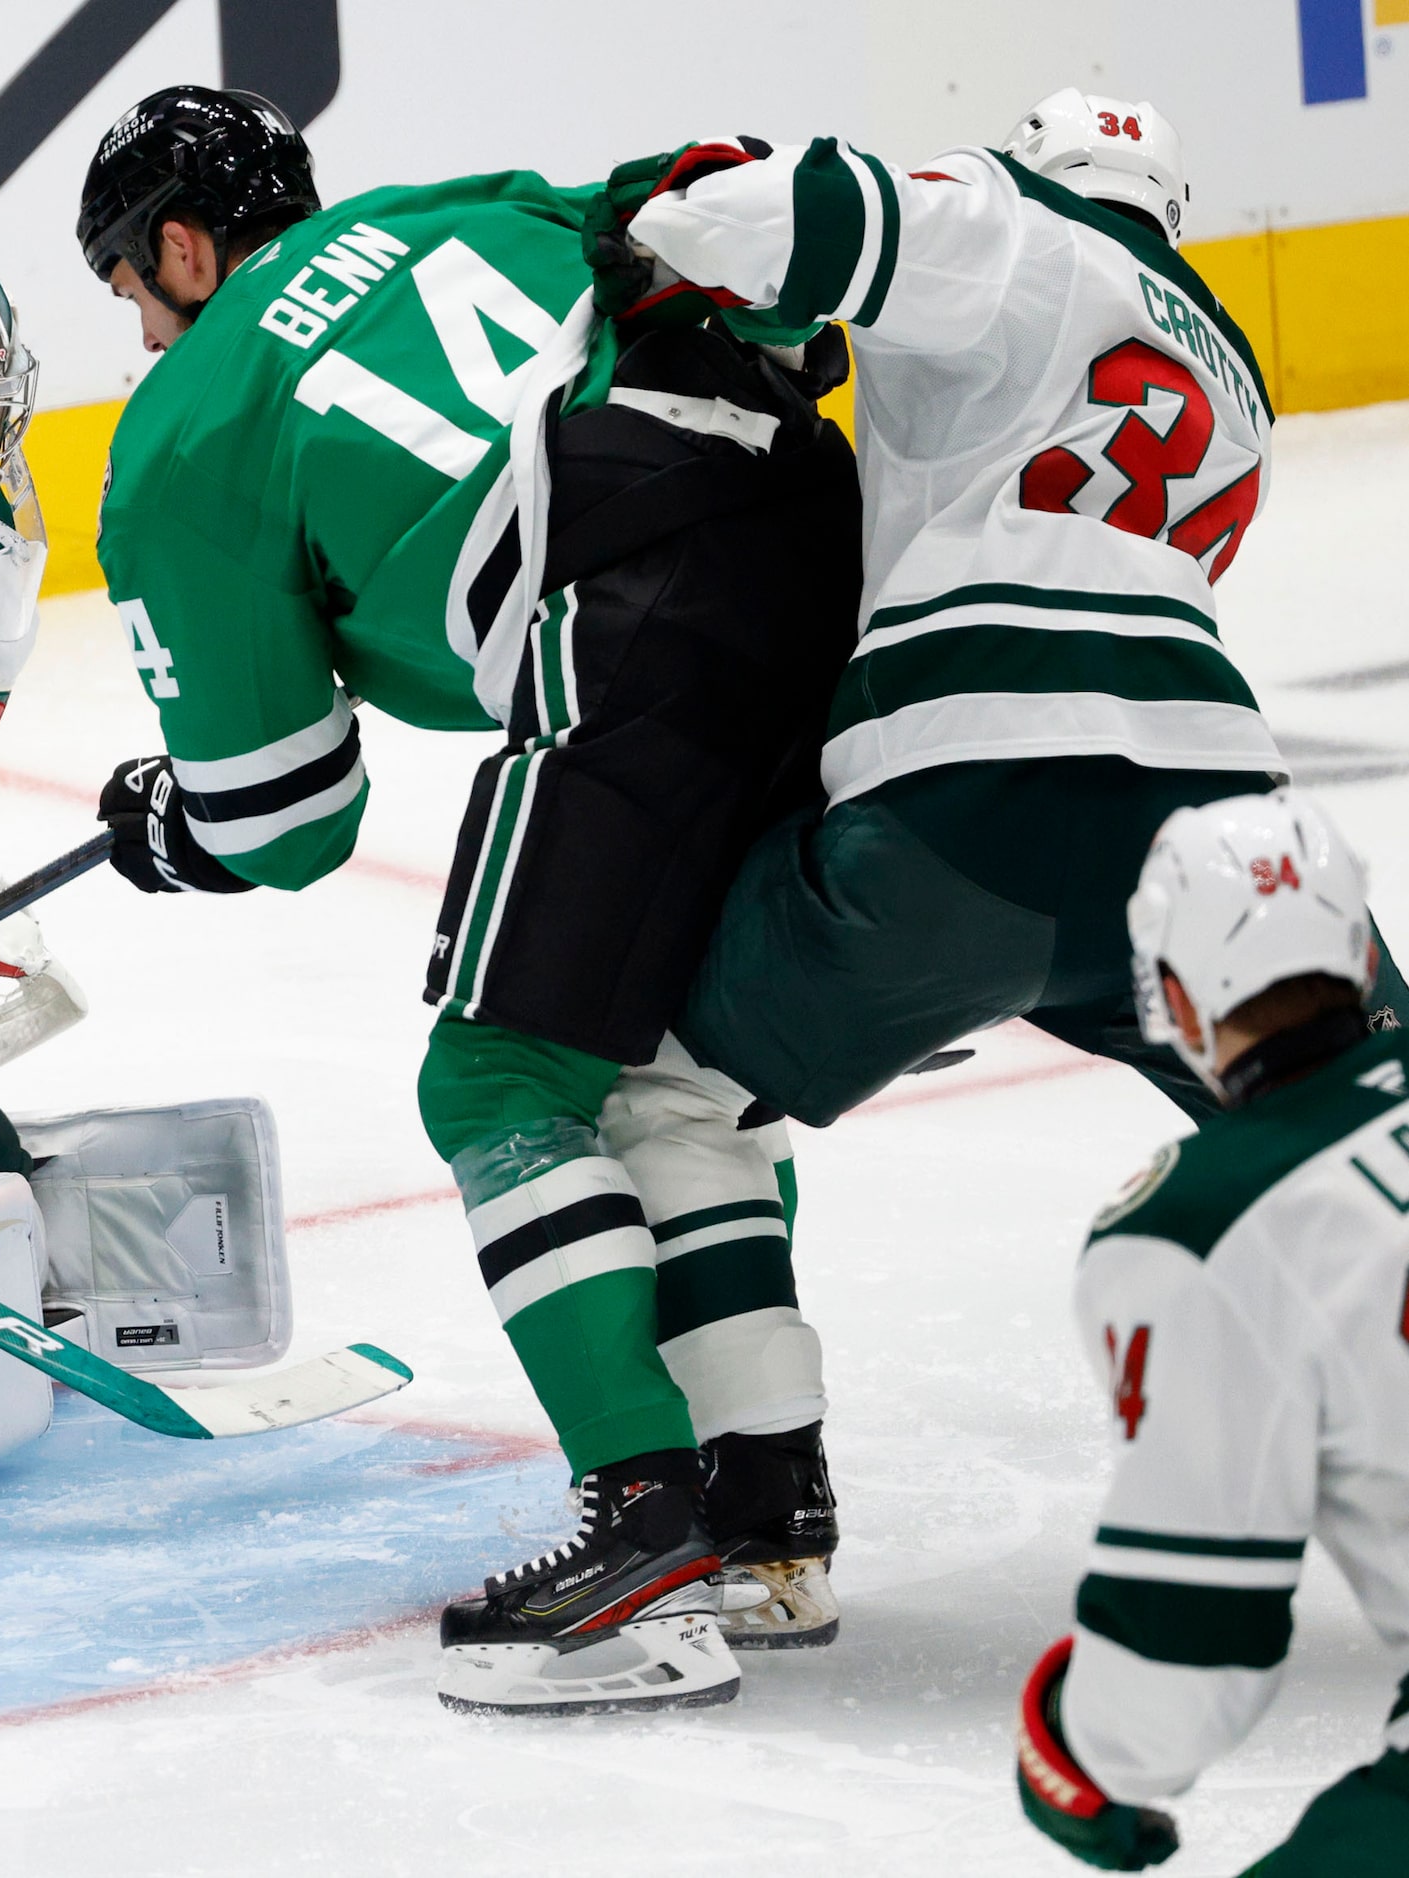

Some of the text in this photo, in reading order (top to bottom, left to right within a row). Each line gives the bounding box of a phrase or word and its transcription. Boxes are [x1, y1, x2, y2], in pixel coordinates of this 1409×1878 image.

[99, 119, 154, 165] TRANSFER
[103, 112, 147, 150] ENERGY
[1097, 111, 1142, 141] 34
[258, 222, 411, 349] BENN
[293, 236, 564, 482] 14
[1138, 272, 1260, 441] CROTTY
[1019, 336, 1261, 588] 34
[555, 1562, 607, 1593] BAUER
